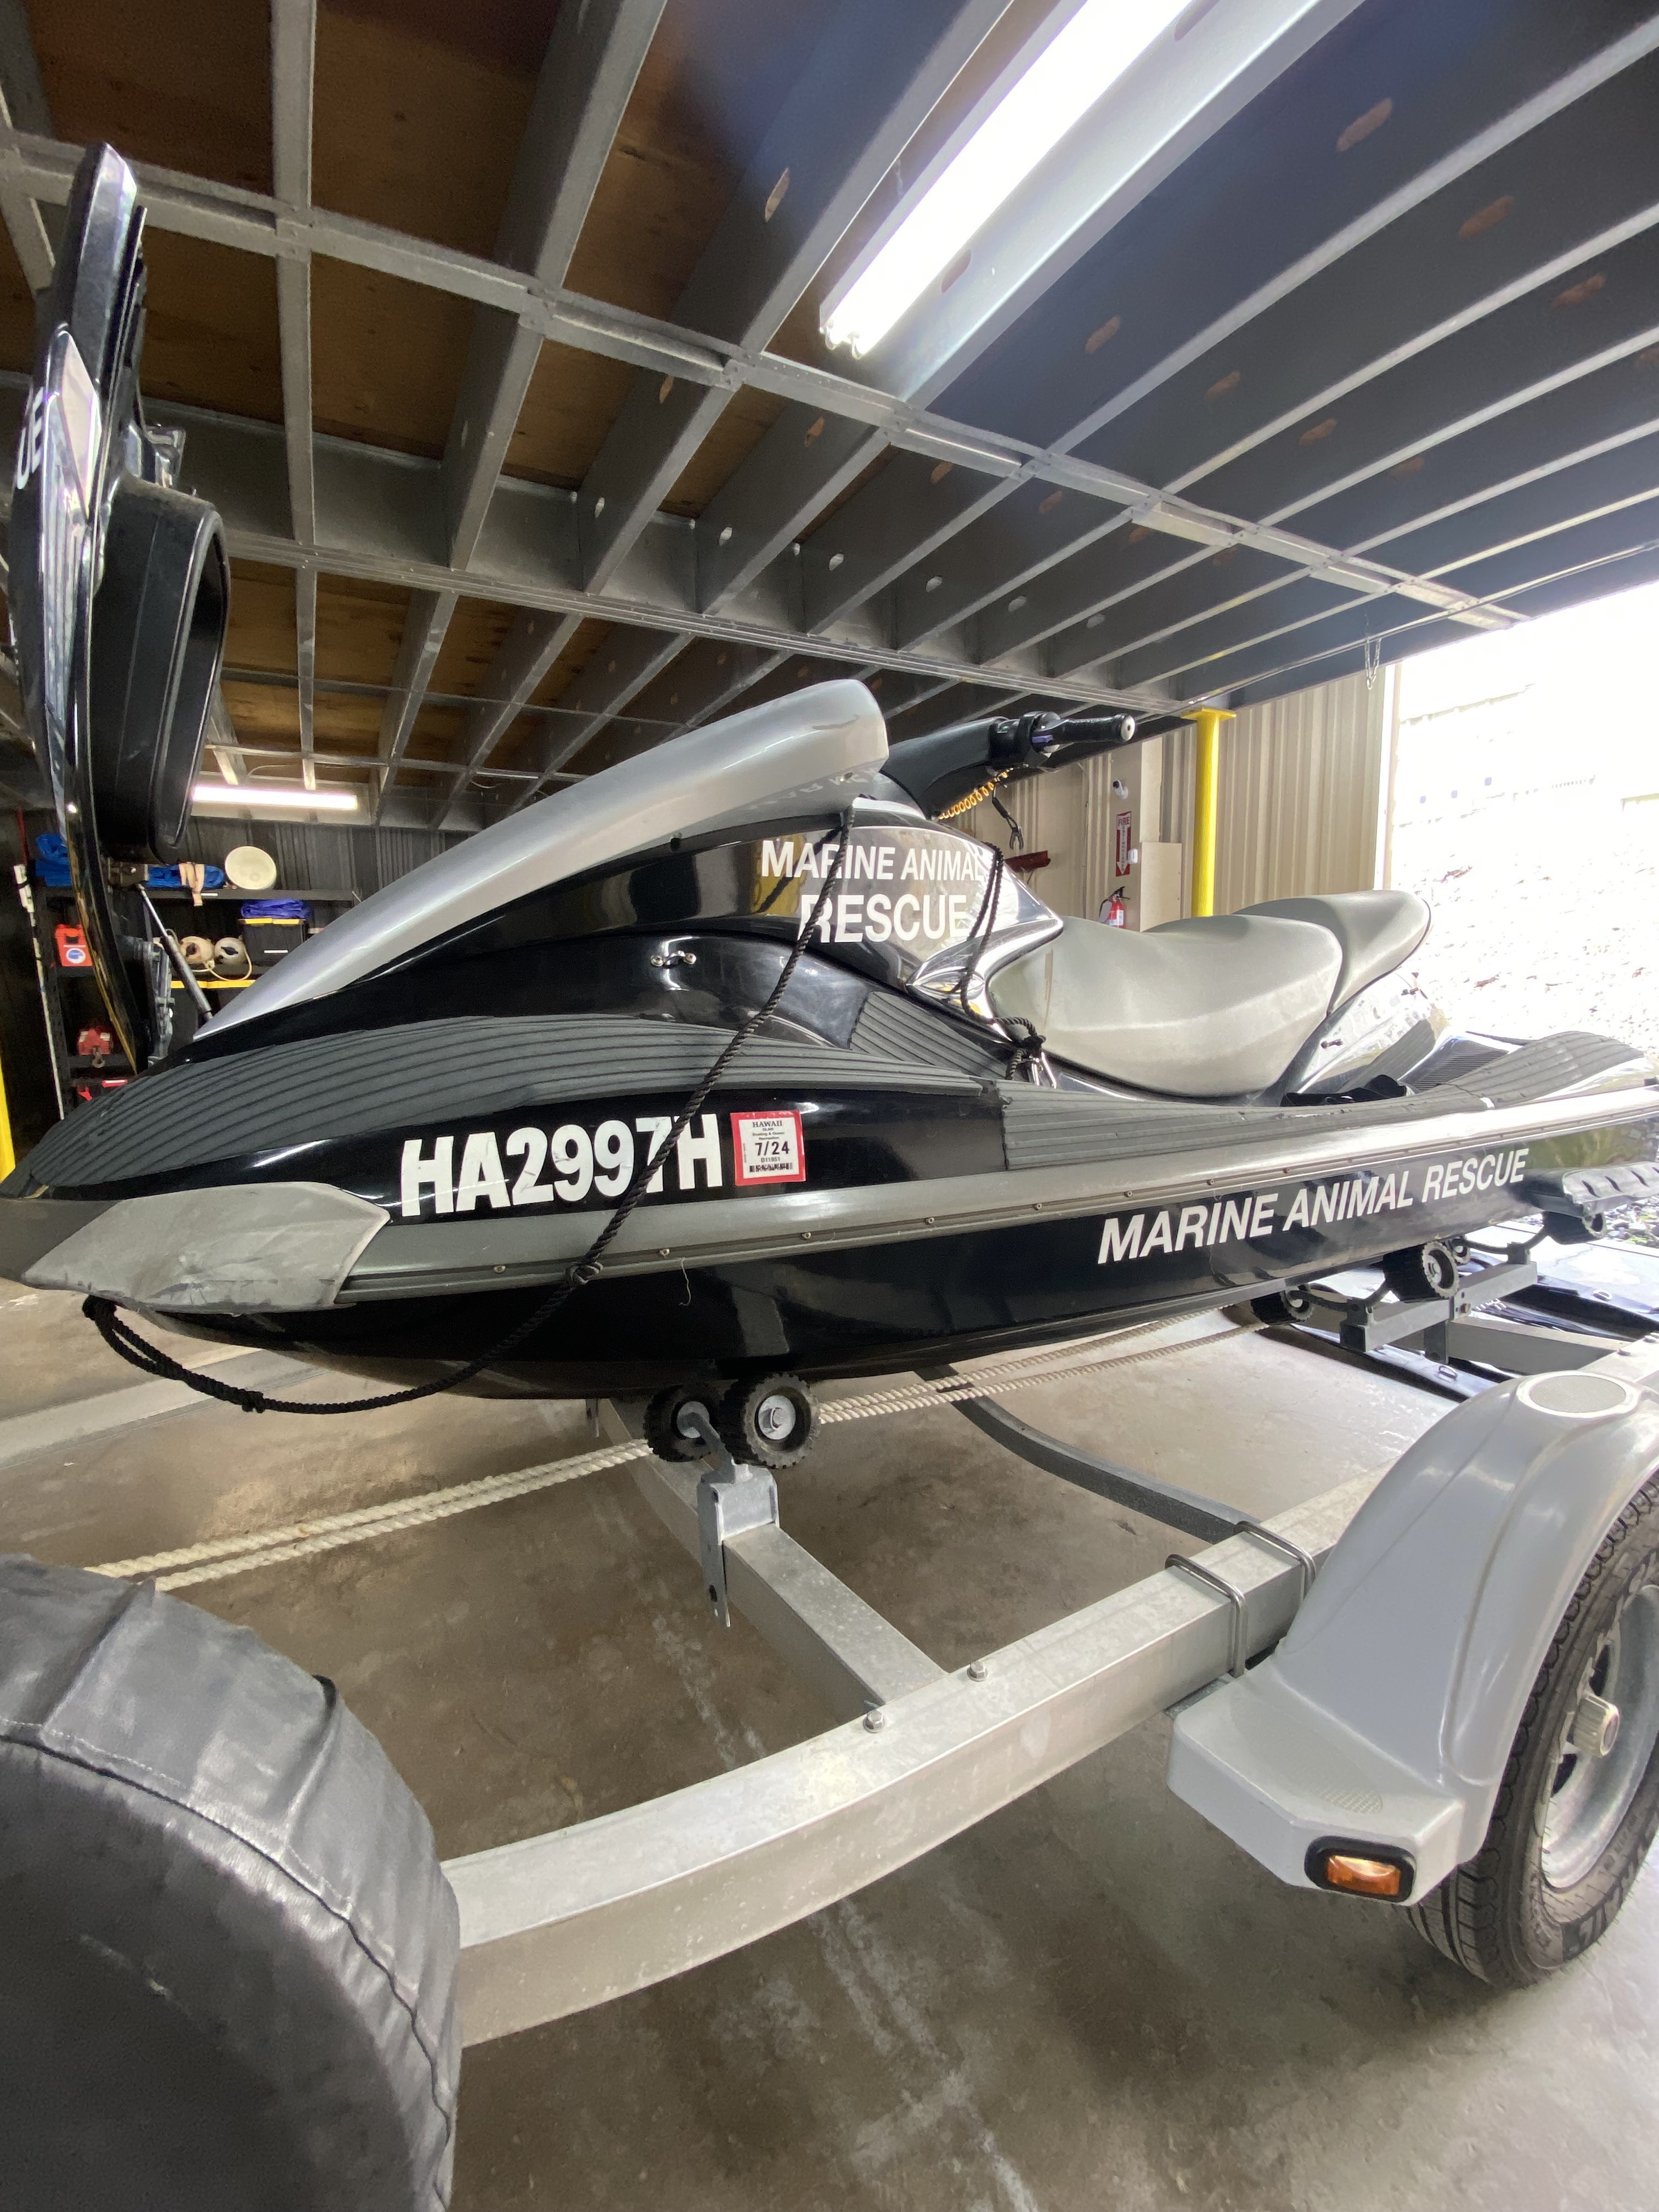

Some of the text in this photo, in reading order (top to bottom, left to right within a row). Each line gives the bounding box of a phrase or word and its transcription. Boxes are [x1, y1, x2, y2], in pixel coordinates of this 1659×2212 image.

[1118, 816, 1130, 827] FIRE
[761, 839, 896, 880] MARINE
[798, 894, 969, 943] RESCUE
[401, 1113, 723, 1217] HA2997H
[755, 1141, 789, 1156] 7/24
[1098, 1148, 1529, 1265] MARINE ANIMAL RESCUE
